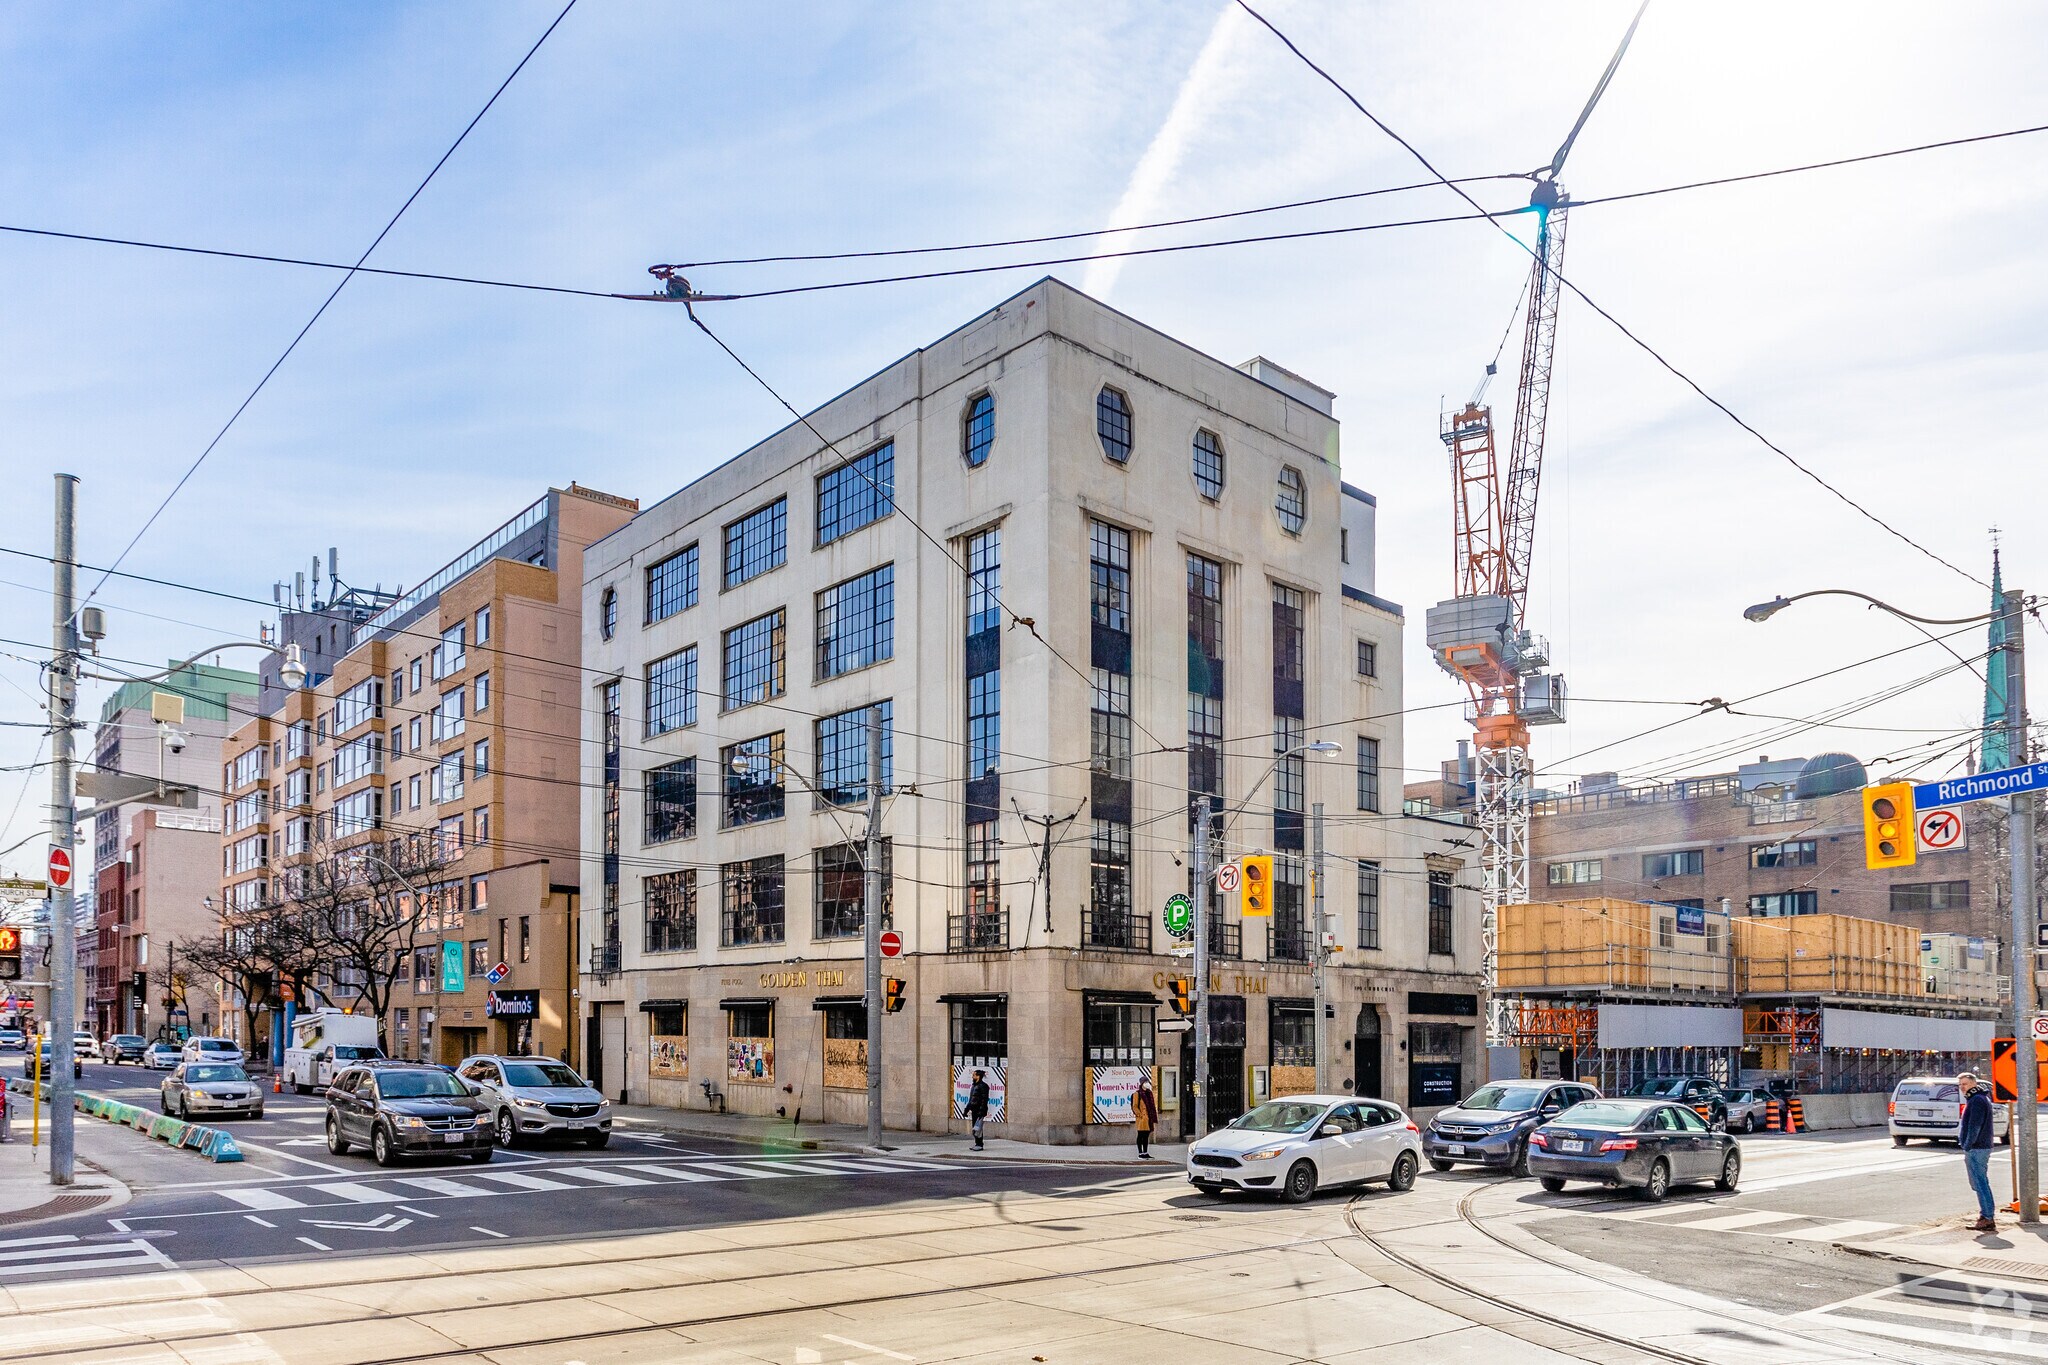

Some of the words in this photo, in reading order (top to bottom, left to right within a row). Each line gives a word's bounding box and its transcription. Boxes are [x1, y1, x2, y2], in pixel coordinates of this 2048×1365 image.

[1939, 768, 2033, 800] Richmond
[2037, 765, 2048, 775] St
[0, 888, 25, 896] HURCH
[1173, 905, 1186, 923] P
[760, 971, 807, 988] GOLDEN
[816, 970, 843, 986] THAI
[1153, 972, 1221, 992] GON
[1235, 976, 1267, 994] THAI
[496, 996, 531, 1014] Domino's
[1123, 1069, 1135, 1077] Open
[956, 1081, 971, 1090] Wome
[988, 1083, 1005, 1092] hion
[1096, 1082, 1125, 1092] Women's
[1908, 1088, 1931, 1097] Painting
[956, 1093, 968, 1105] Pop
[1096, 1095, 1125, 1107] Pop-Up
